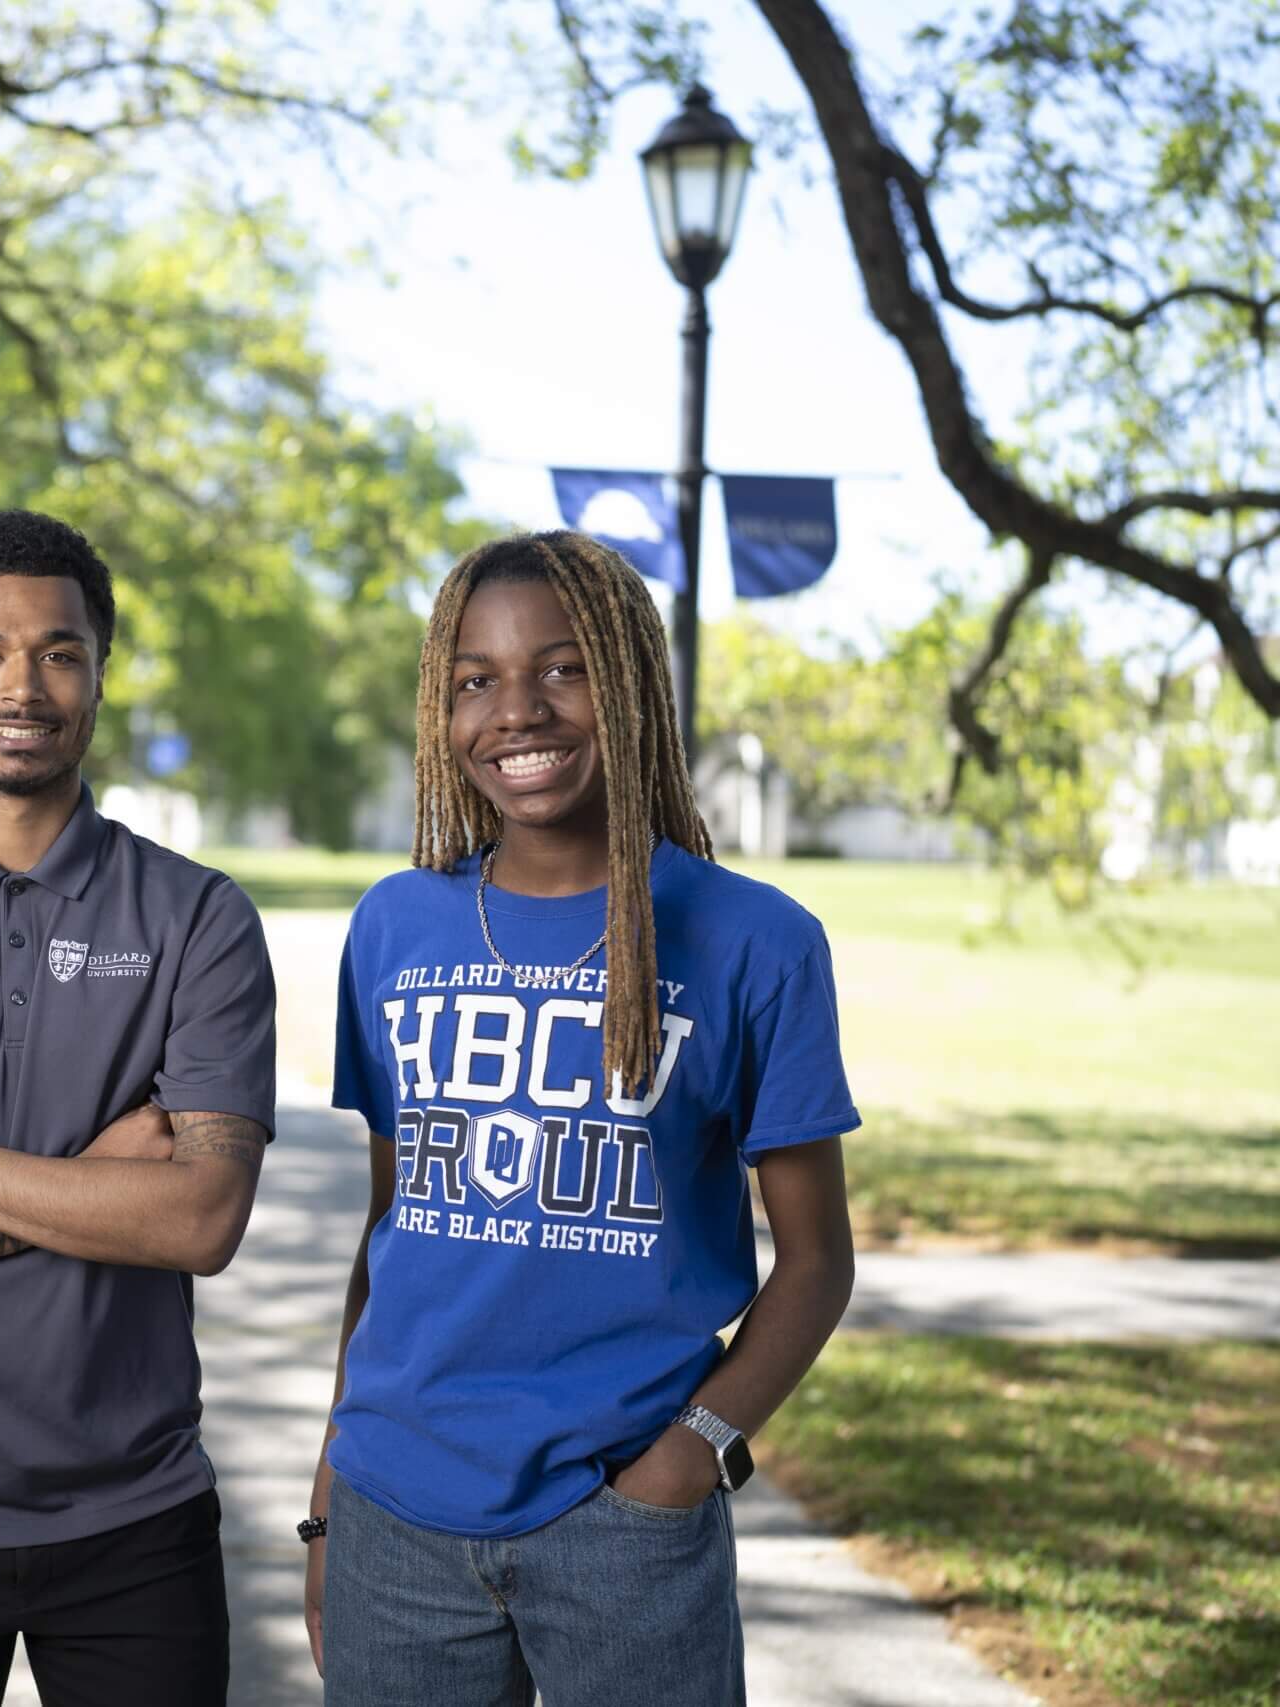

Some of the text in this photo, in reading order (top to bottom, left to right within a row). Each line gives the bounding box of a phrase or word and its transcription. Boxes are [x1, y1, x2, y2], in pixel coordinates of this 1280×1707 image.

[88, 952, 151, 966] DILLARD
[87, 969, 148, 977] UNIVERSITY
[396, 965, 502, 990] DILLARD
[383, 994, 694, 1117] HBCU
[396, 1205, 658, 1258] ARE BLACK HISTORY
